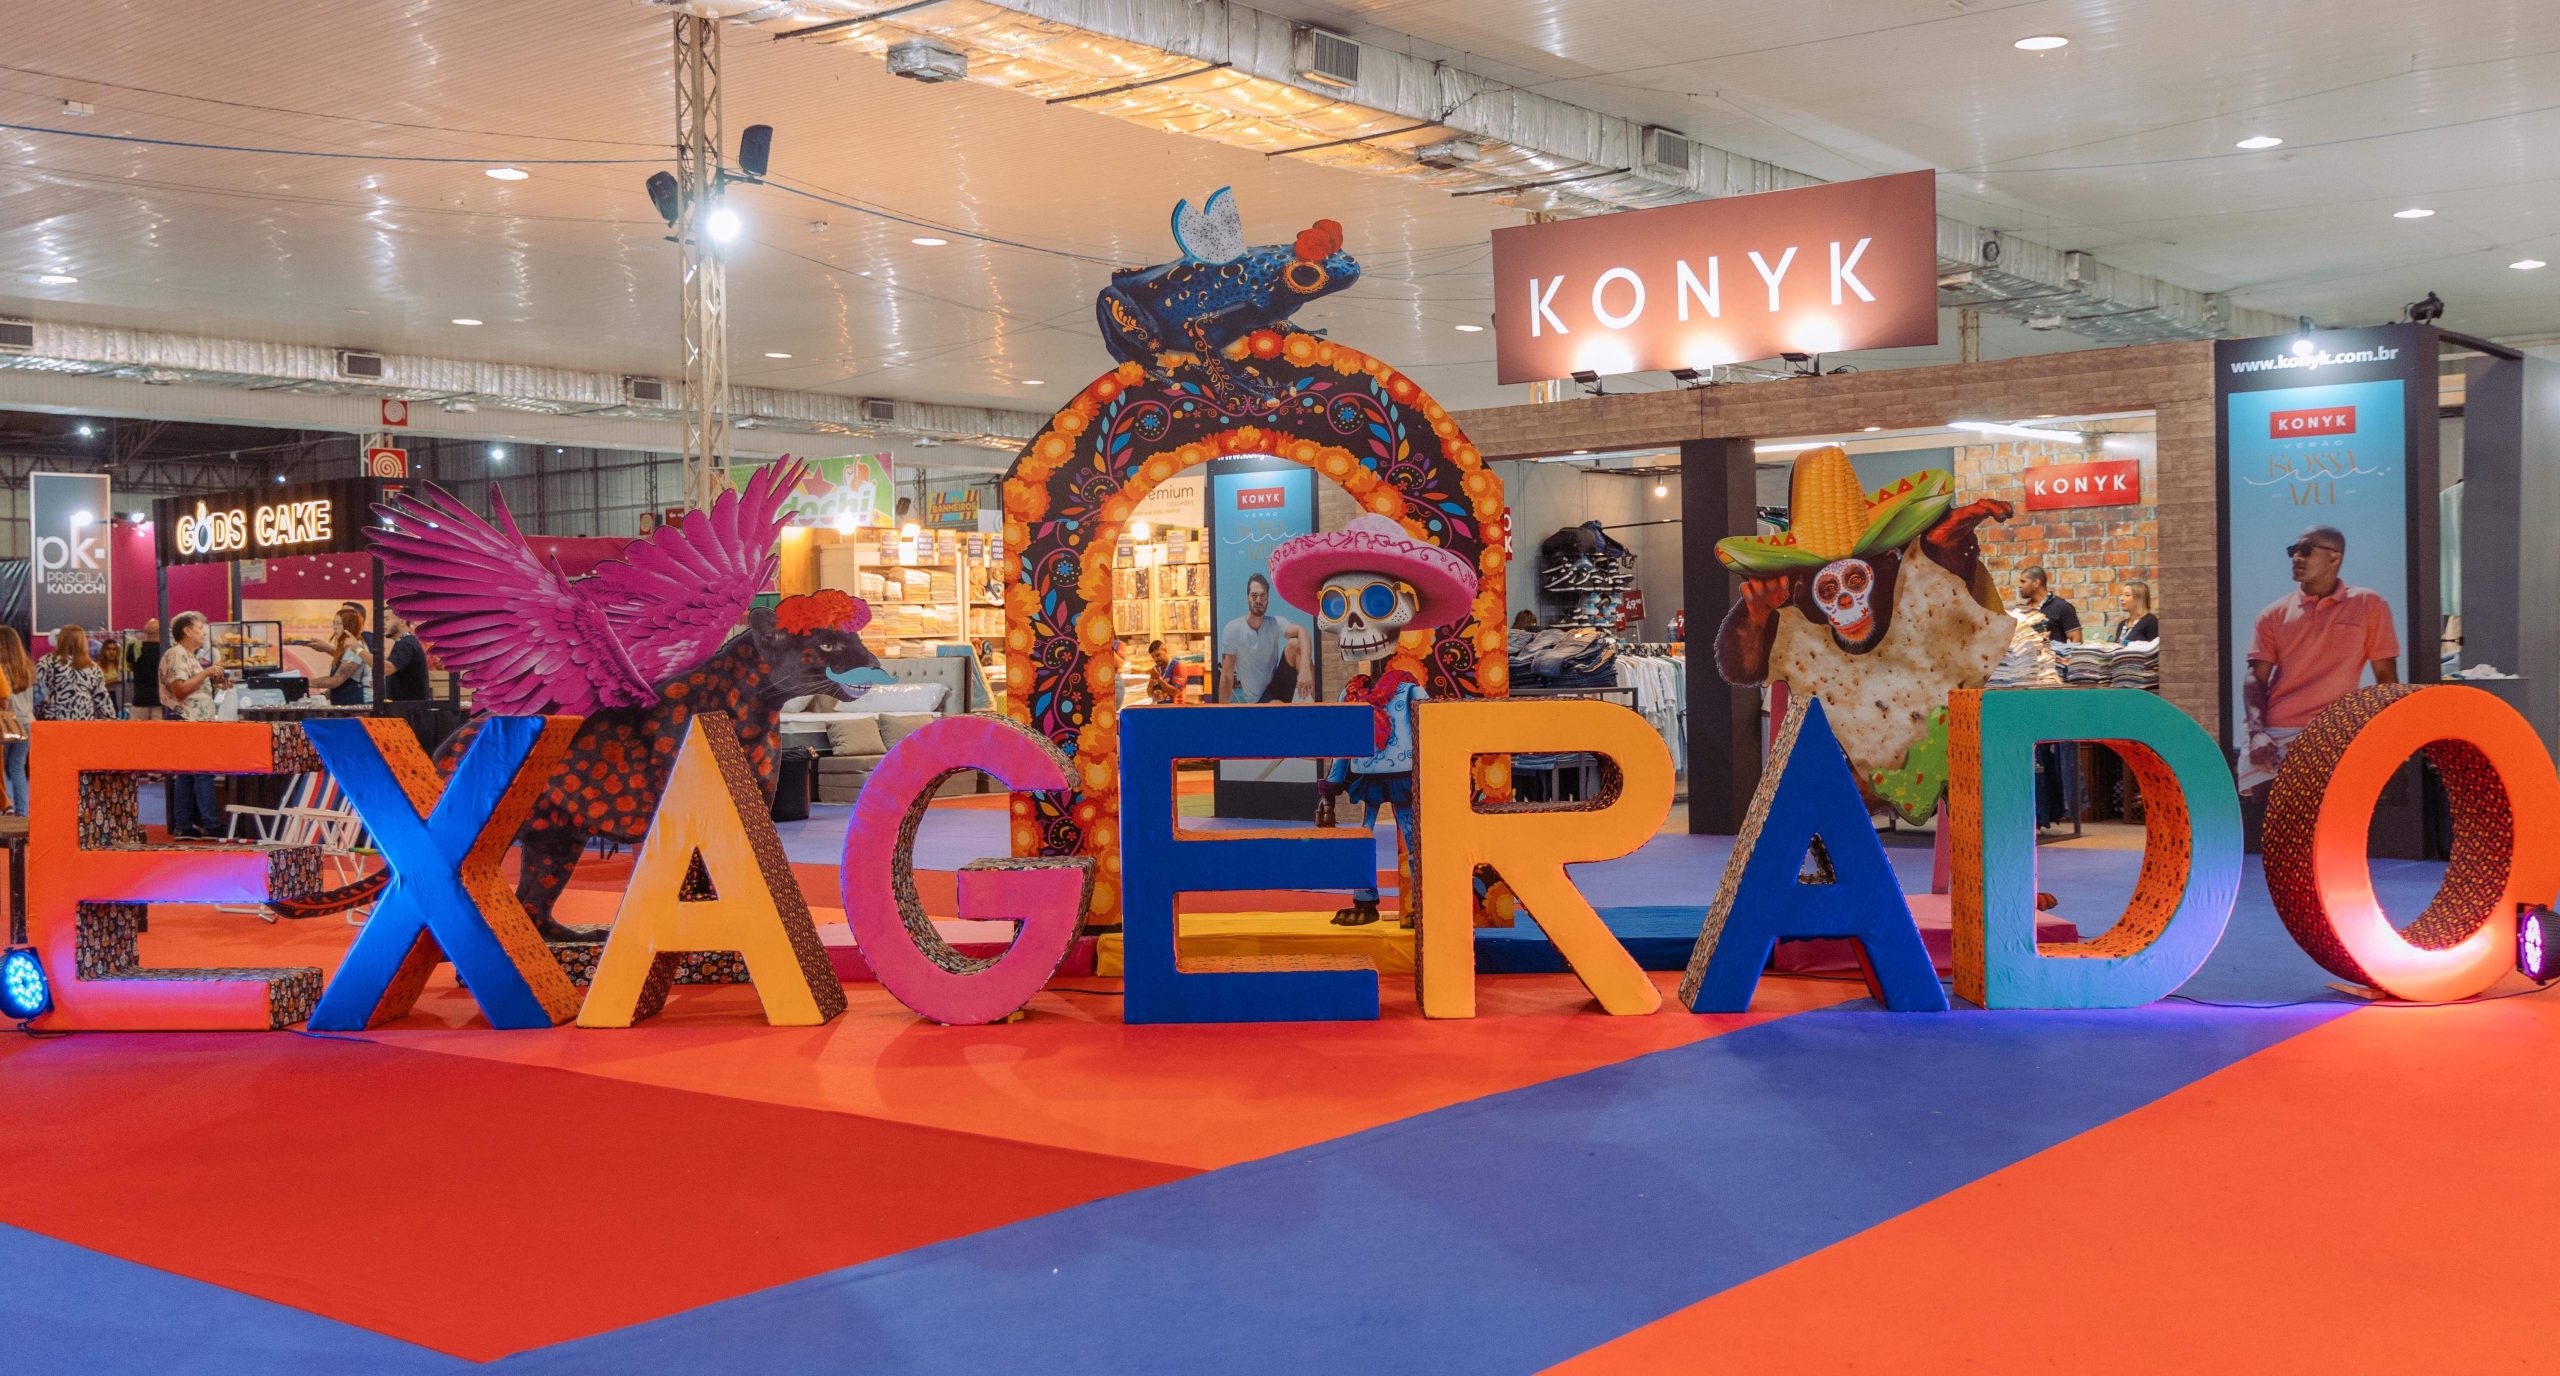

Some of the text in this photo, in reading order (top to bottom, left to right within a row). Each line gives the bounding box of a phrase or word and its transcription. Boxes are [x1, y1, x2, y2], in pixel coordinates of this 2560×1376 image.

[1530, 238, 1876, 337] KONYK
[2231, 346, 2399, 373] www.konyk.com.br
[2278, 415, 2347, 430] KONYK
[1142, 484, 1194, 501] emium
[2034, 474, 2127, 496] KONYK
[932, 501, 977, 513] BANHEIROS
[1241, 493, 1280, 505] KONYK
[255, 500, 332, 547] CAKE
[46, 571, 106, 584] PRISCILA
[47, 583, 107, 594] KADOCHI
[28, 685, 2555, 1033] EXAGERADO
